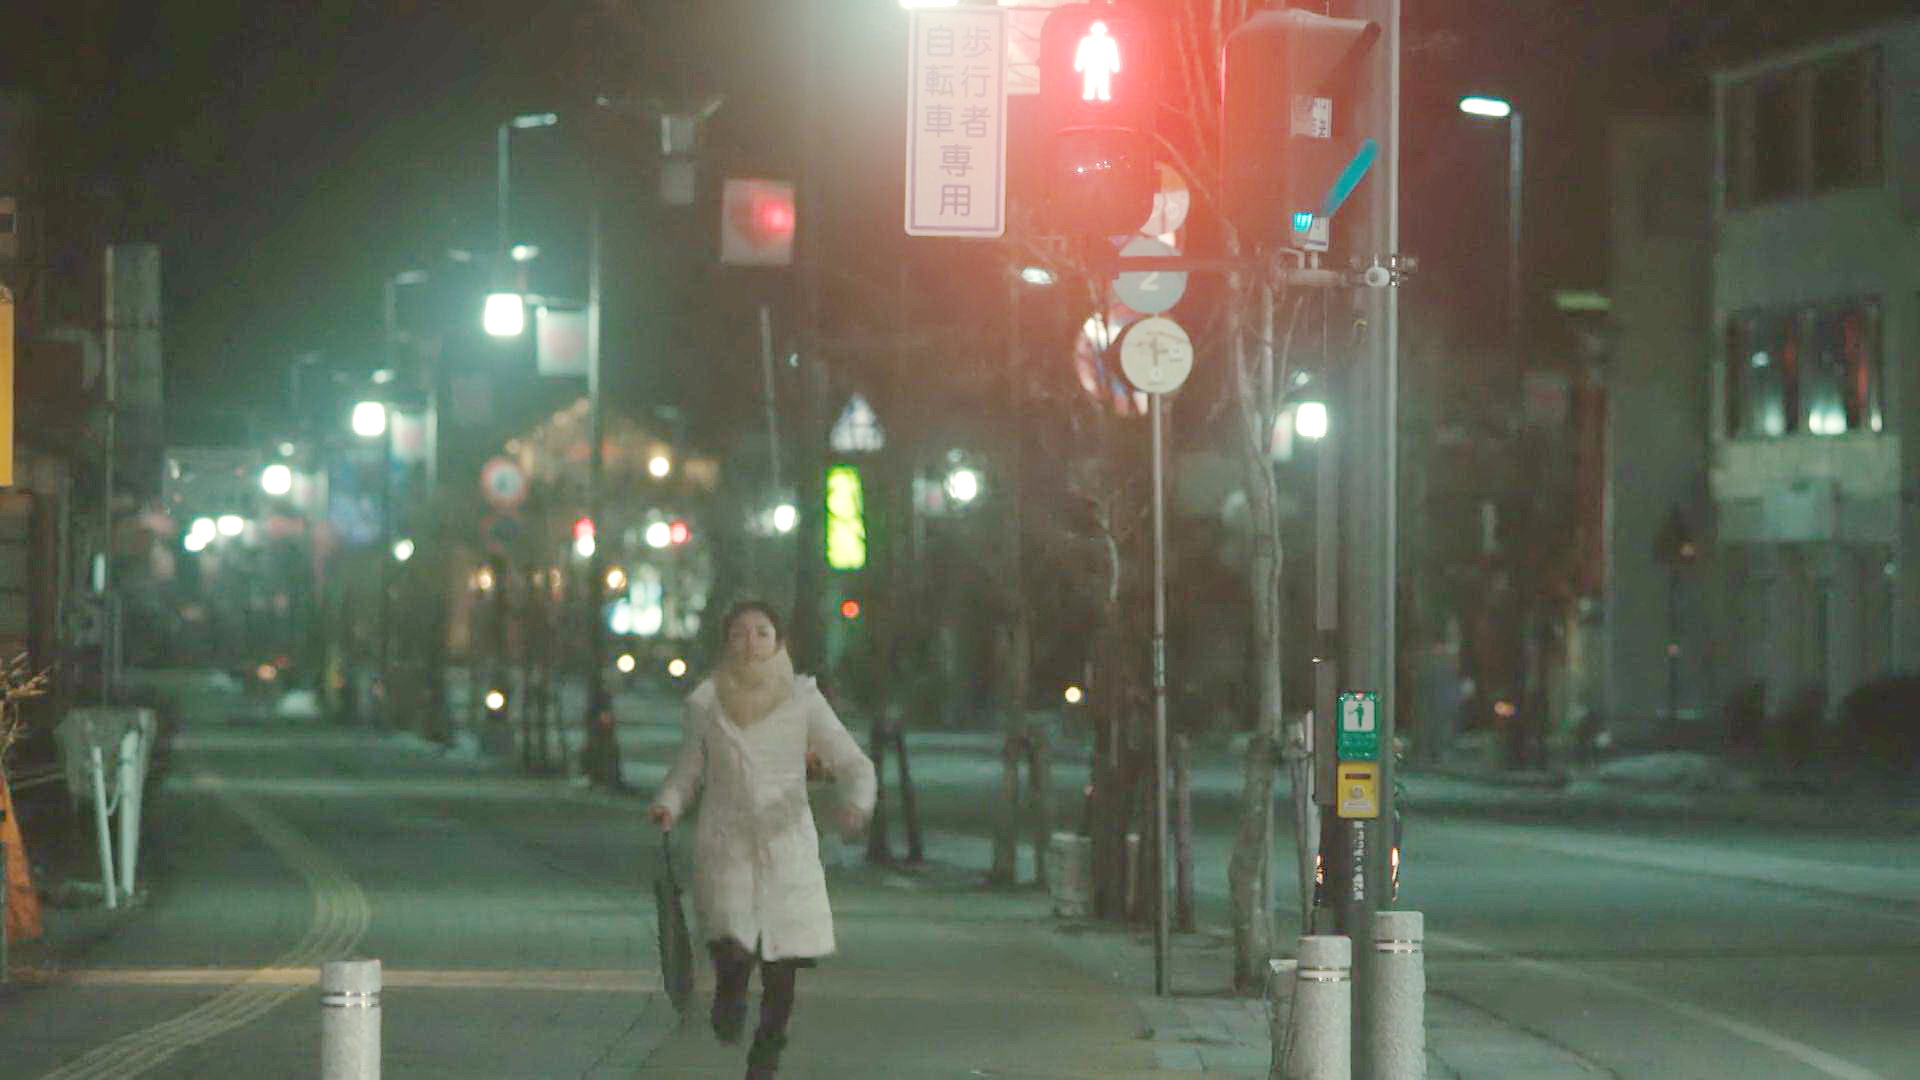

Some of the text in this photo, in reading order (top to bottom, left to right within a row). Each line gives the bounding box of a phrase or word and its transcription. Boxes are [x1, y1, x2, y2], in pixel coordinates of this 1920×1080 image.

[924, 25, 955, 138] 自転車
[960, 26, 992, 138] 歩行者
[938, 143, 974, 217] 専用
